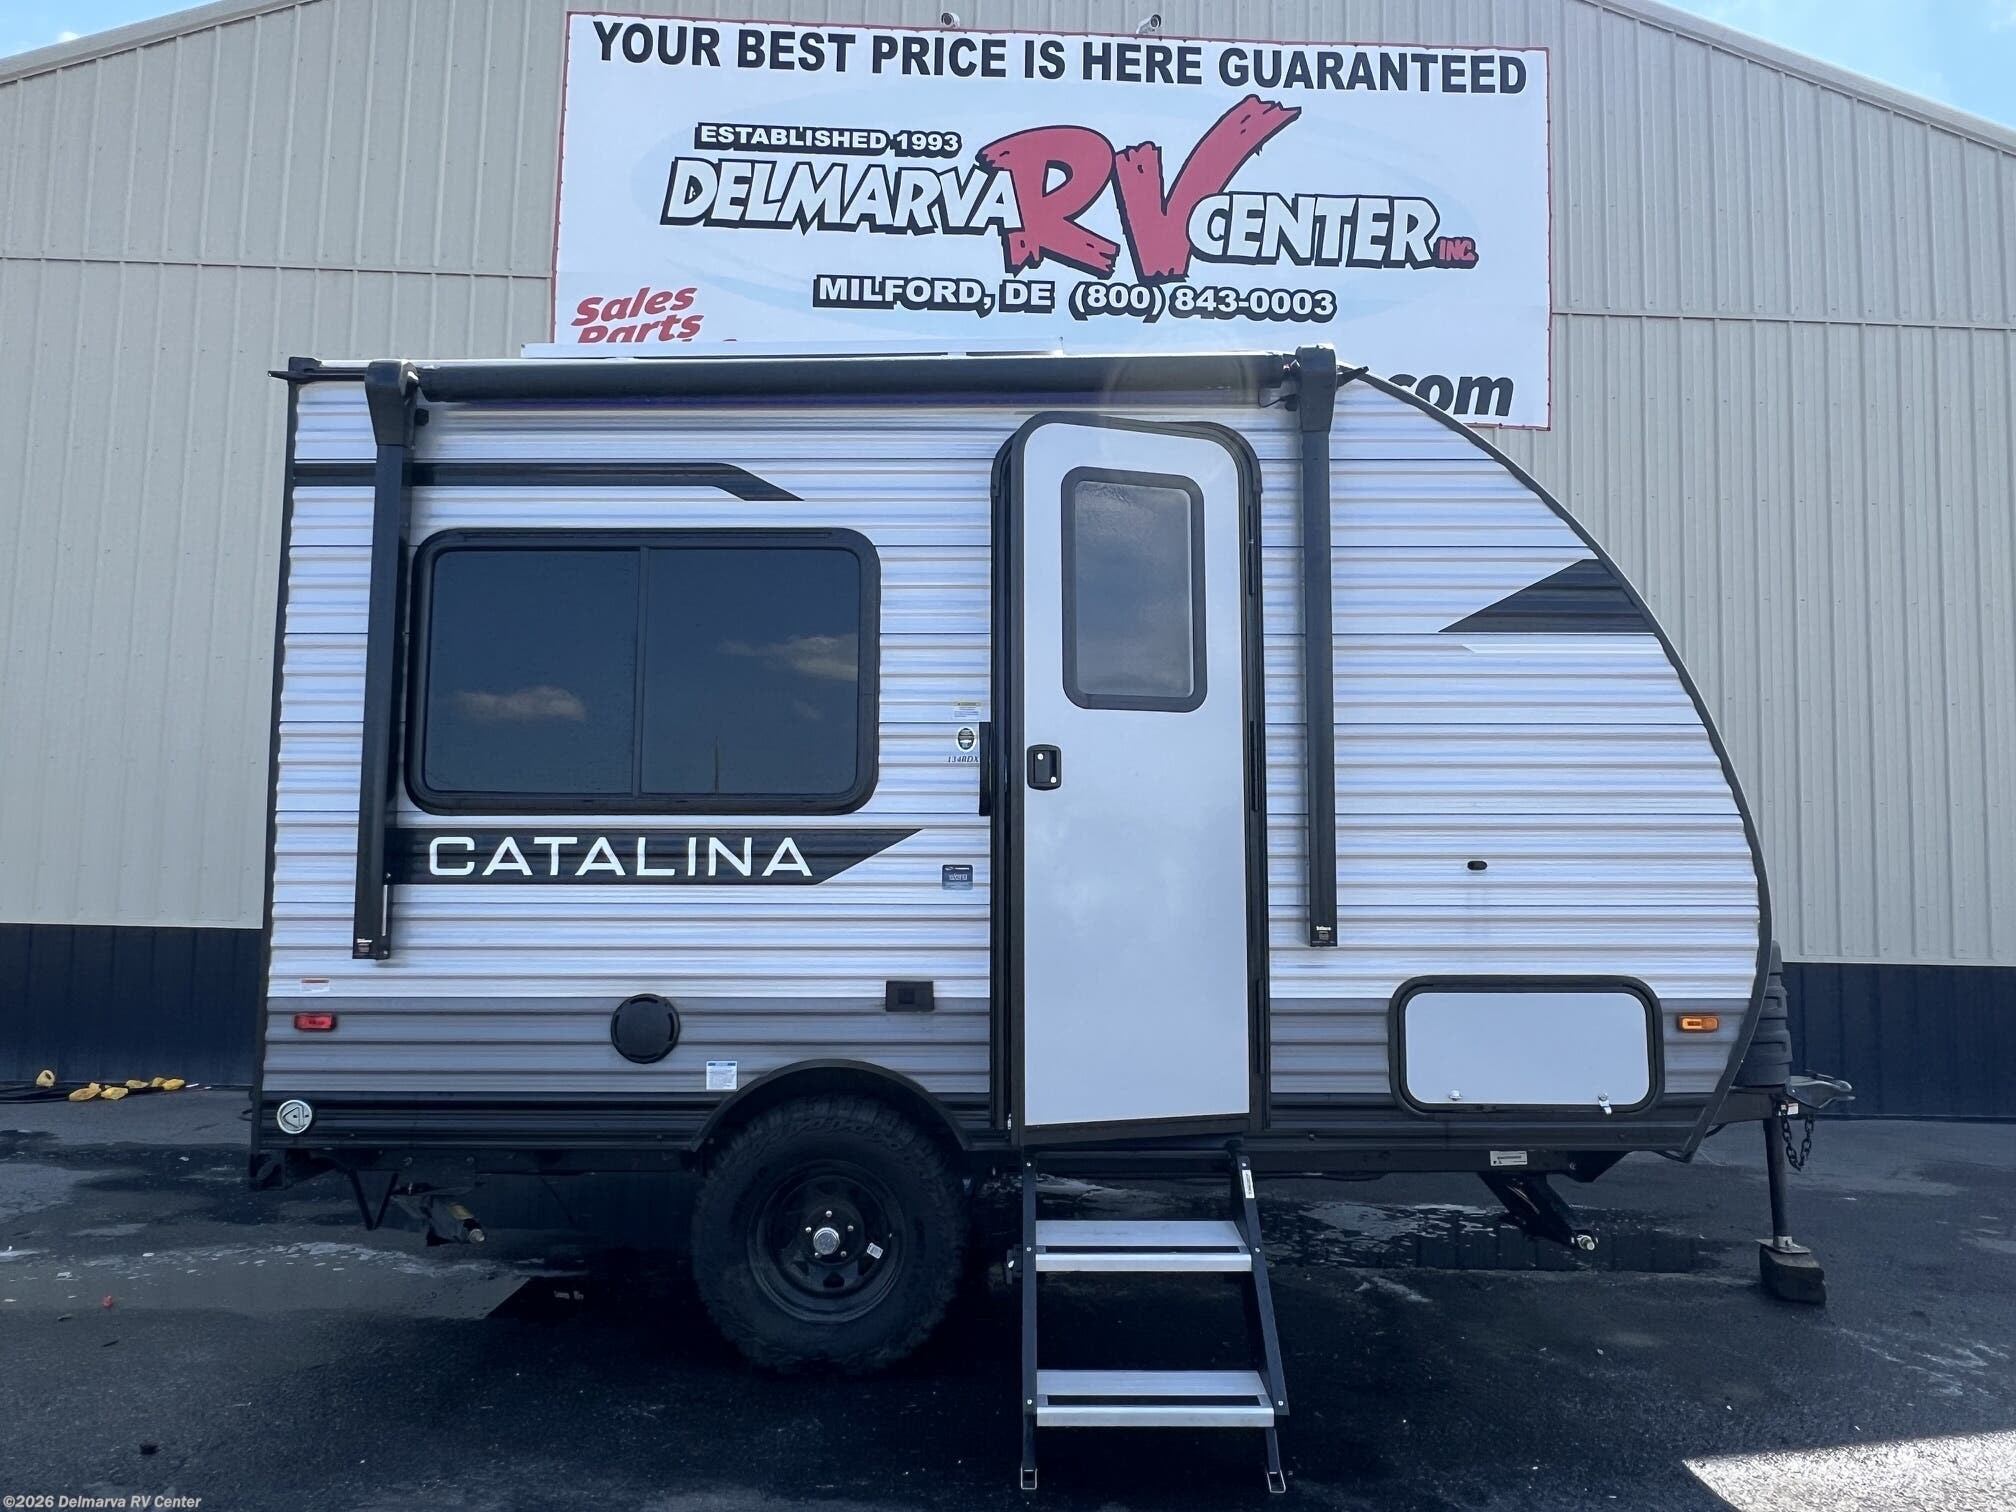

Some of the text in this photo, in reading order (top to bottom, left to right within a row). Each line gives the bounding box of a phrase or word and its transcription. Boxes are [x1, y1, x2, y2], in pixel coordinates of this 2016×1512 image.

[594, 22, 1528, 94] YOUR BEST PRICE IS HERE GUARANTEED
[699, 124, 960, 153] ESTABLISHED 1993
[664, 157, 1024, 235] DELMARVA
[976, 94, 1301, 283] RV
[1188, 193, 1440, 267] CENTER
[571, 287, 698, 327] Sales
[817, 276, 1336, 320] MILFORD, DE (800) 843-0003
[428, 836, 812, 877] CATALINA
